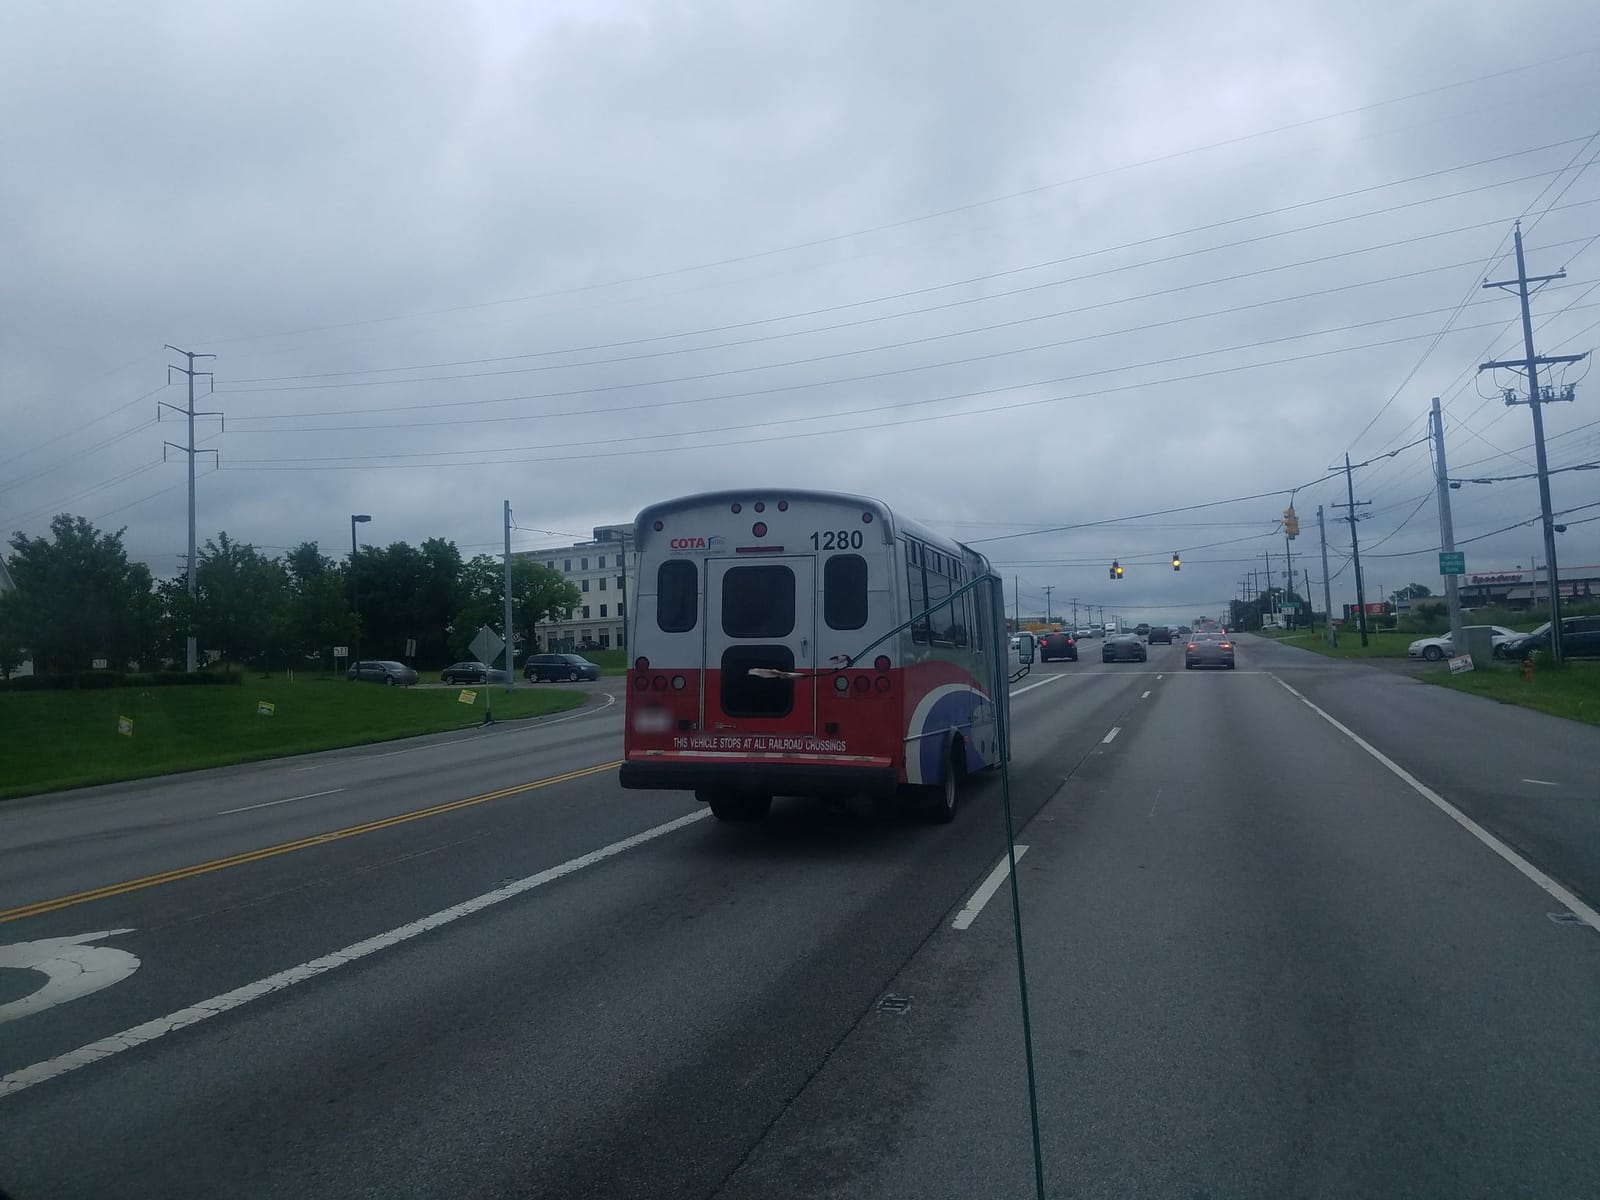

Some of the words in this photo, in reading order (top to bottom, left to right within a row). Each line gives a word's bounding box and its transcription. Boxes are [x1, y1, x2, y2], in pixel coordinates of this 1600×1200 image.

[670, 537, 706, 549] COTA
[810, 530, 863, 551] 1280
[1472, 574, 1522, 584] Speedway
[673, 737, 688, 749] THIS
[690, 737, 718, 749] VEHICLE
[719, 737, 741, 749] STOPS
[743, 738, 753, 749] AT
[753, 738, 767, 749] ALL
[768, 738, 803, 750] RAILROAD
[805, 739, 847, 752] CROSSINGS
